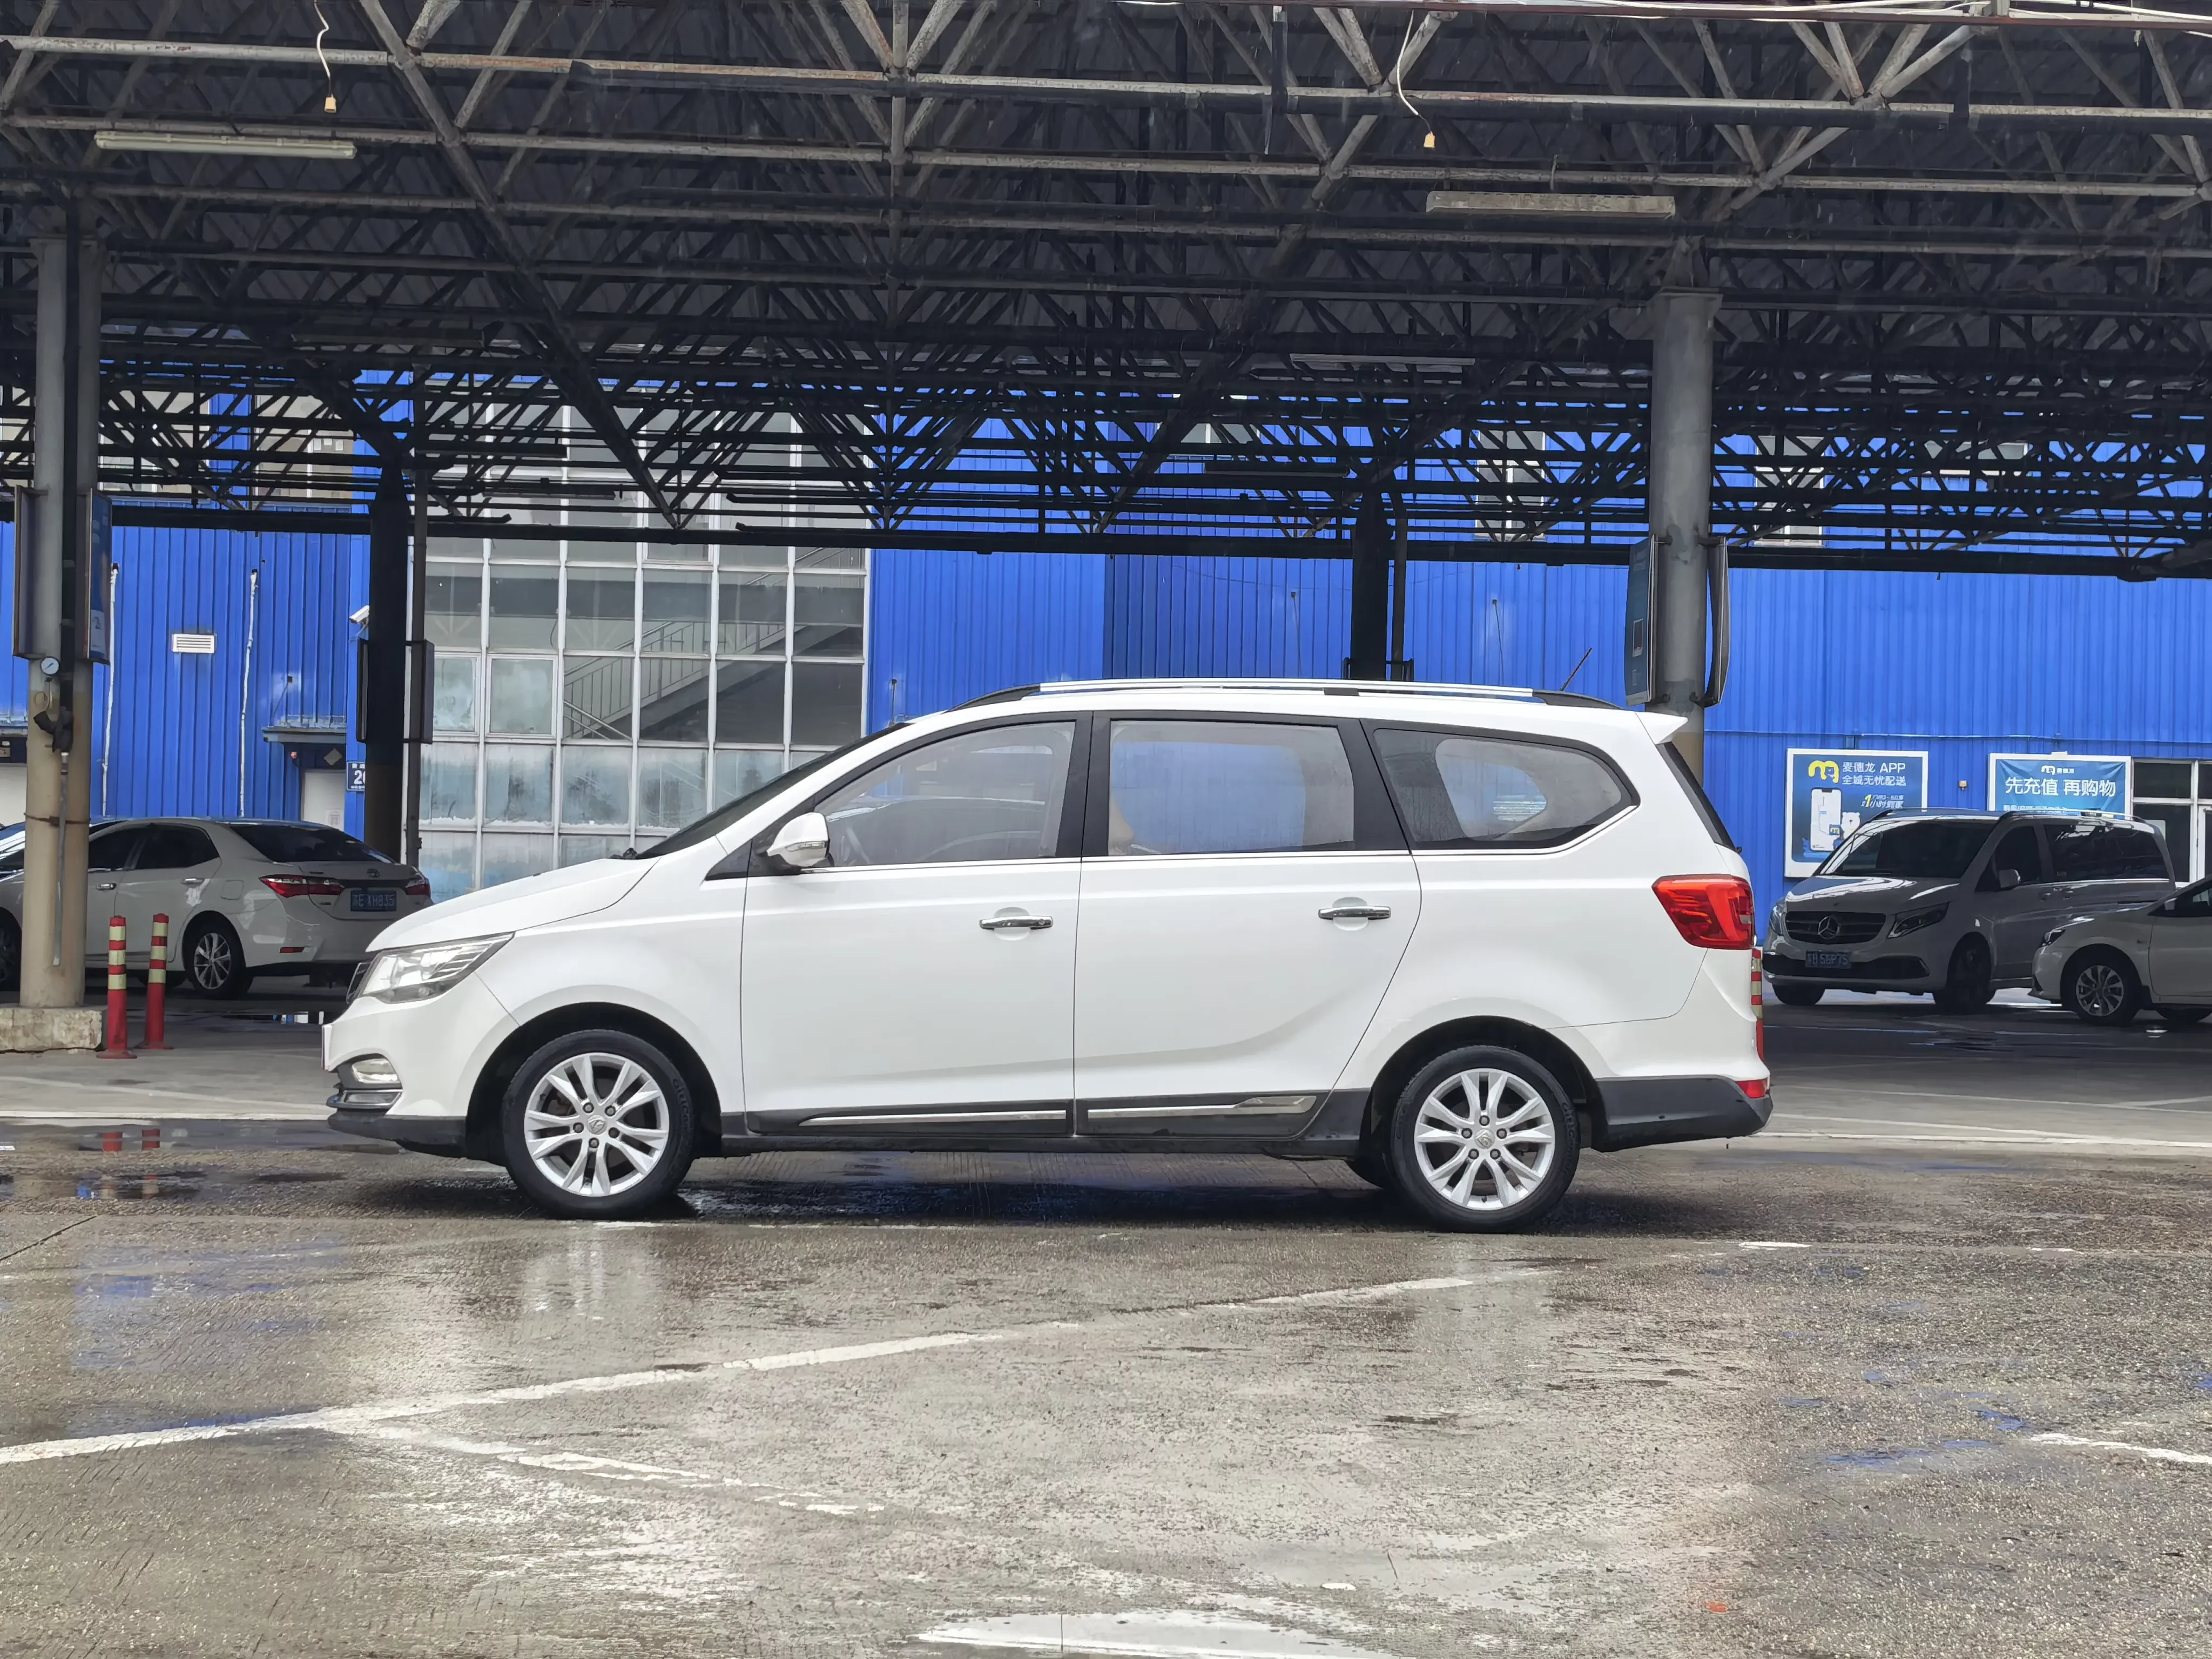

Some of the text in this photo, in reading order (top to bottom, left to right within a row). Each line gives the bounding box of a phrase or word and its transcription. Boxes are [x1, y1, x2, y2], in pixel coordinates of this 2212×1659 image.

[1842, 762, 1906, 773] 麦德龙 APP
[2005, 777, 2116, 797] 先充值 再购物
